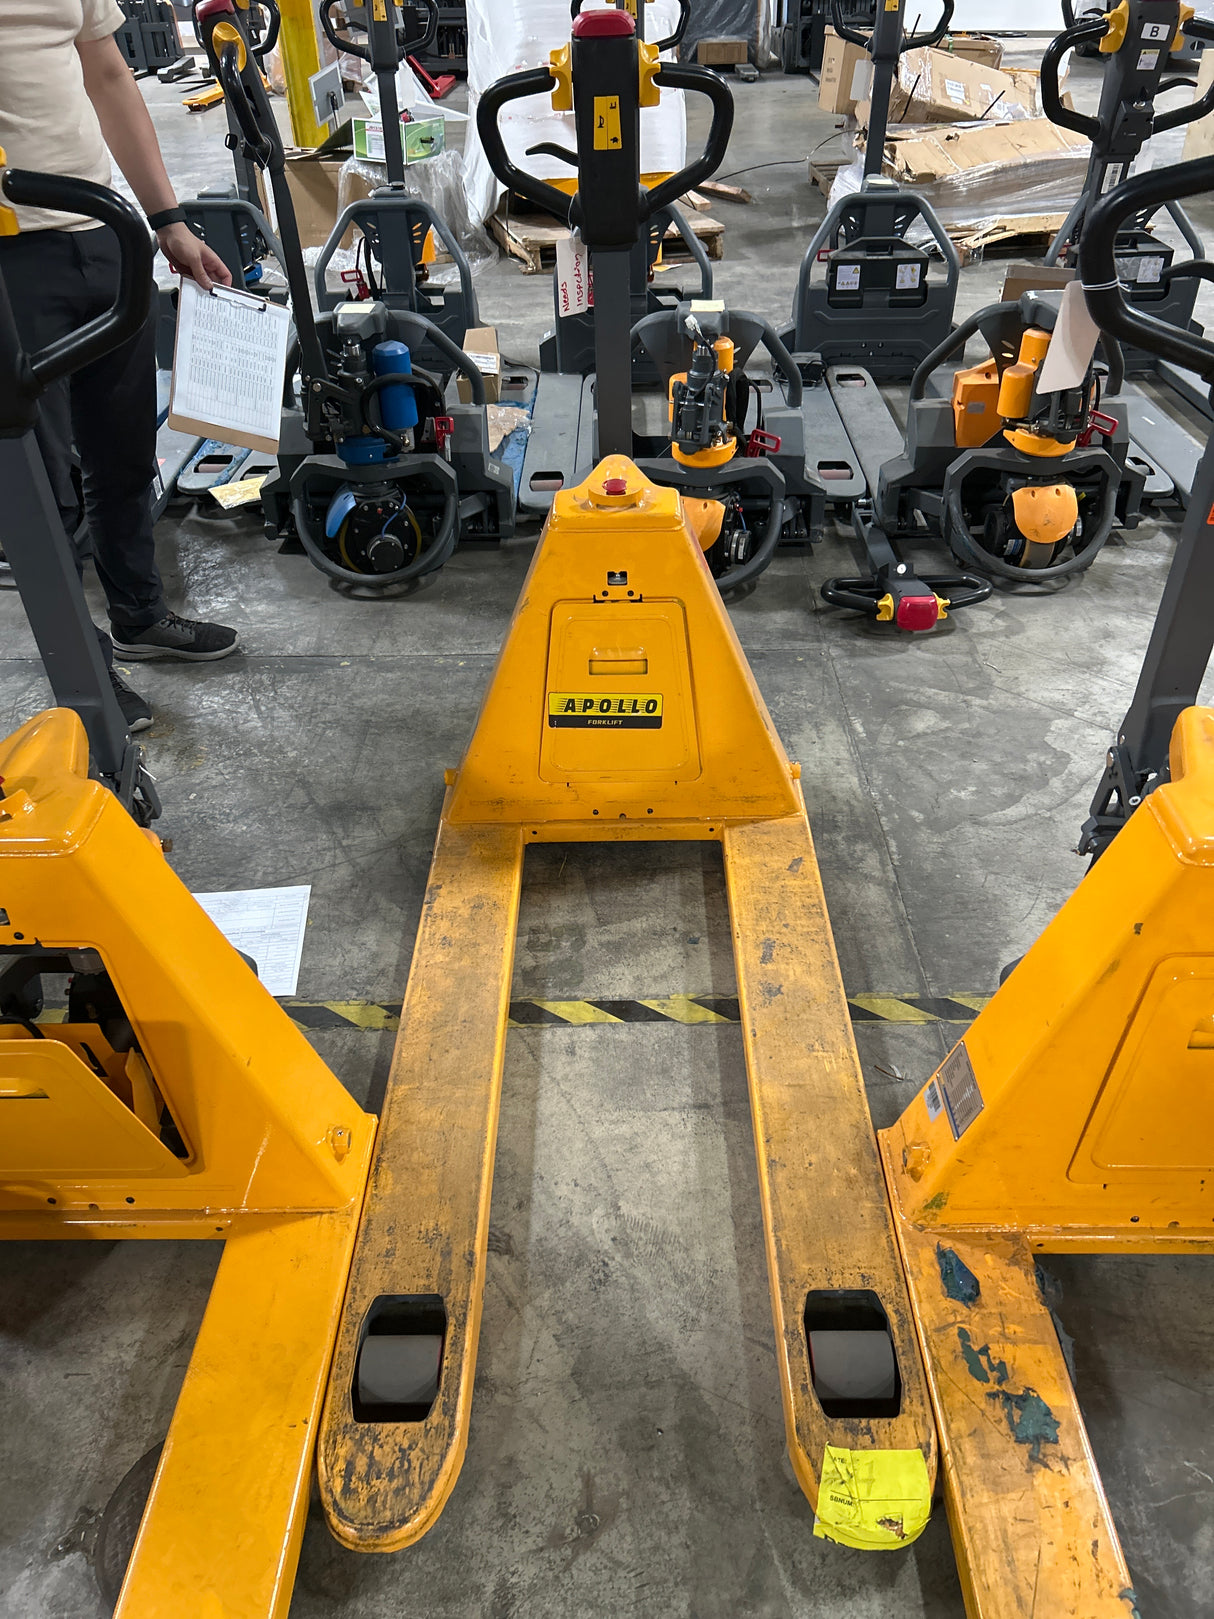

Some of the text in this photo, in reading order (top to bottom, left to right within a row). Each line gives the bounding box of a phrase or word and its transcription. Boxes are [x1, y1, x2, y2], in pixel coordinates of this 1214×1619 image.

[1150, 25, 1160, 37] B
[561, 281, 570, 312] Needs
[563, 698, 658, 714] APOLLO
